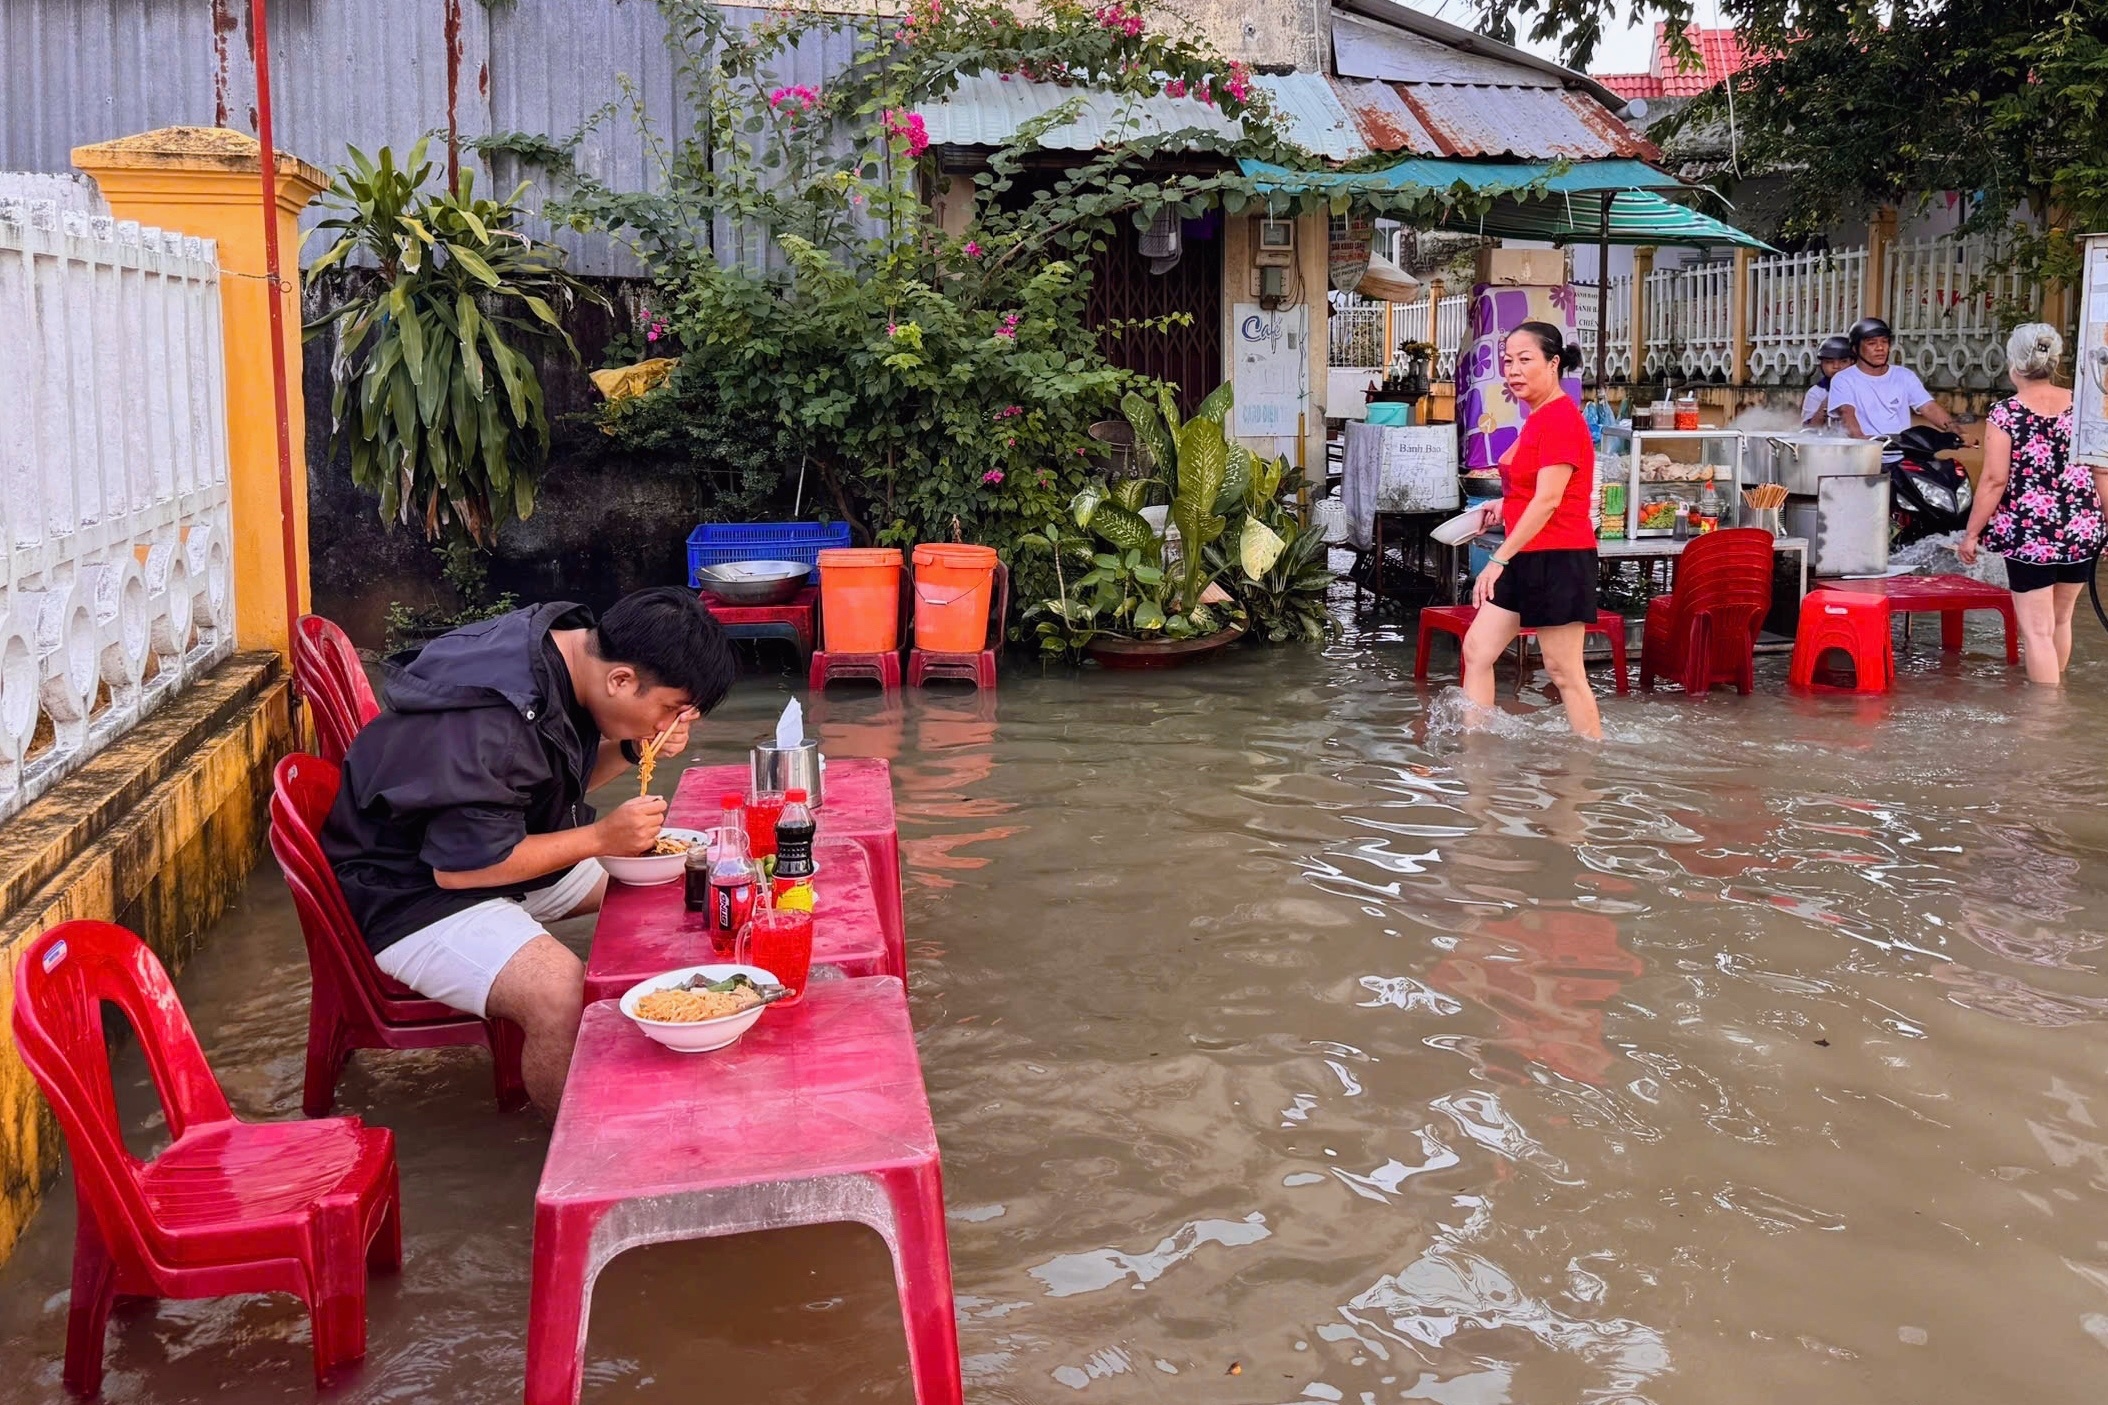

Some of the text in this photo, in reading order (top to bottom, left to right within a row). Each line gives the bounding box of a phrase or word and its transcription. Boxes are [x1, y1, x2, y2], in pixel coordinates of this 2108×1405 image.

[1241, 316, 1282, 348] Café
[1399, 443, 1441, 453] Bánh Bao
[720, 891, 729, 927] STING
